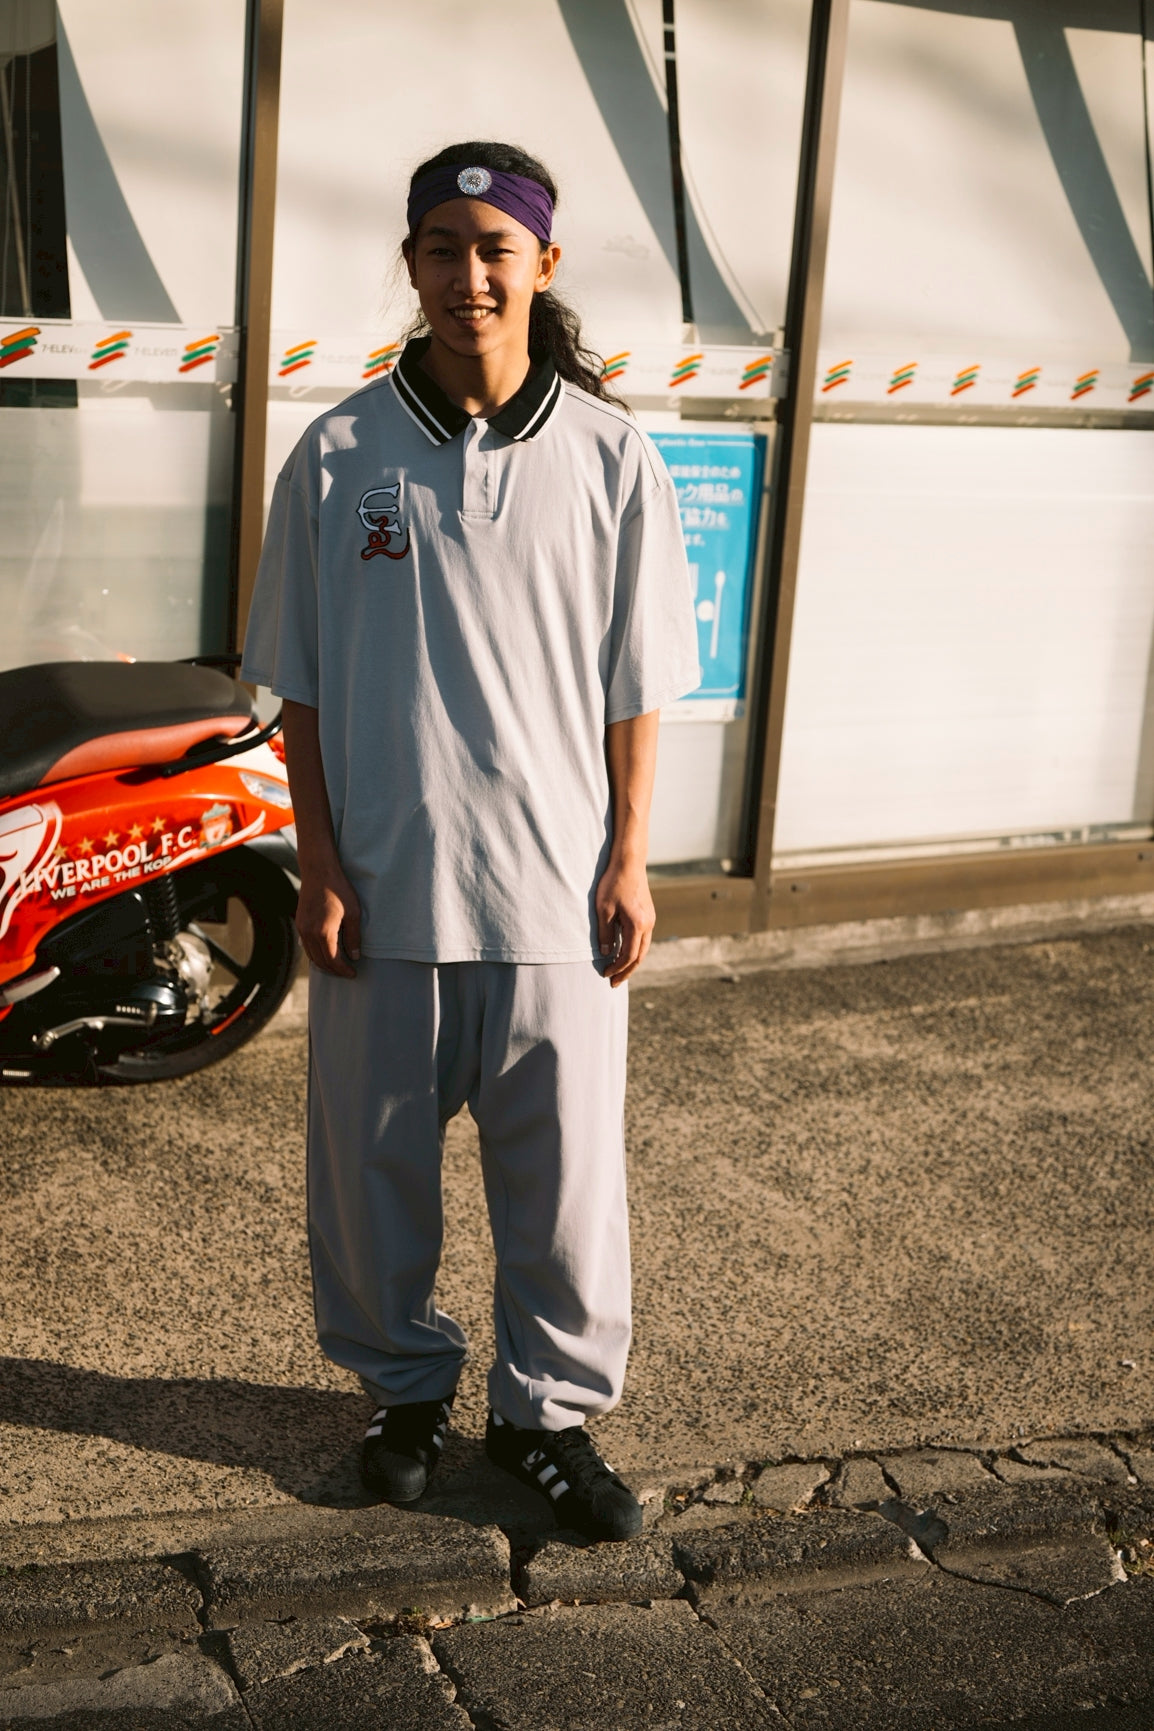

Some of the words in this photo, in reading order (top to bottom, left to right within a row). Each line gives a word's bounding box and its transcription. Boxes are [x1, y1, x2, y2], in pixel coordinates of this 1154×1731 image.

[20, 841, 154, 893] LIVERPOOL
[161, 825, 197, 856] F.C.
[50, 885, 77, 900] WE
[80, 876, 110, 893] ARE
[113, 866, 141, 883] THE
[144, 855, 173, 875] KOP
